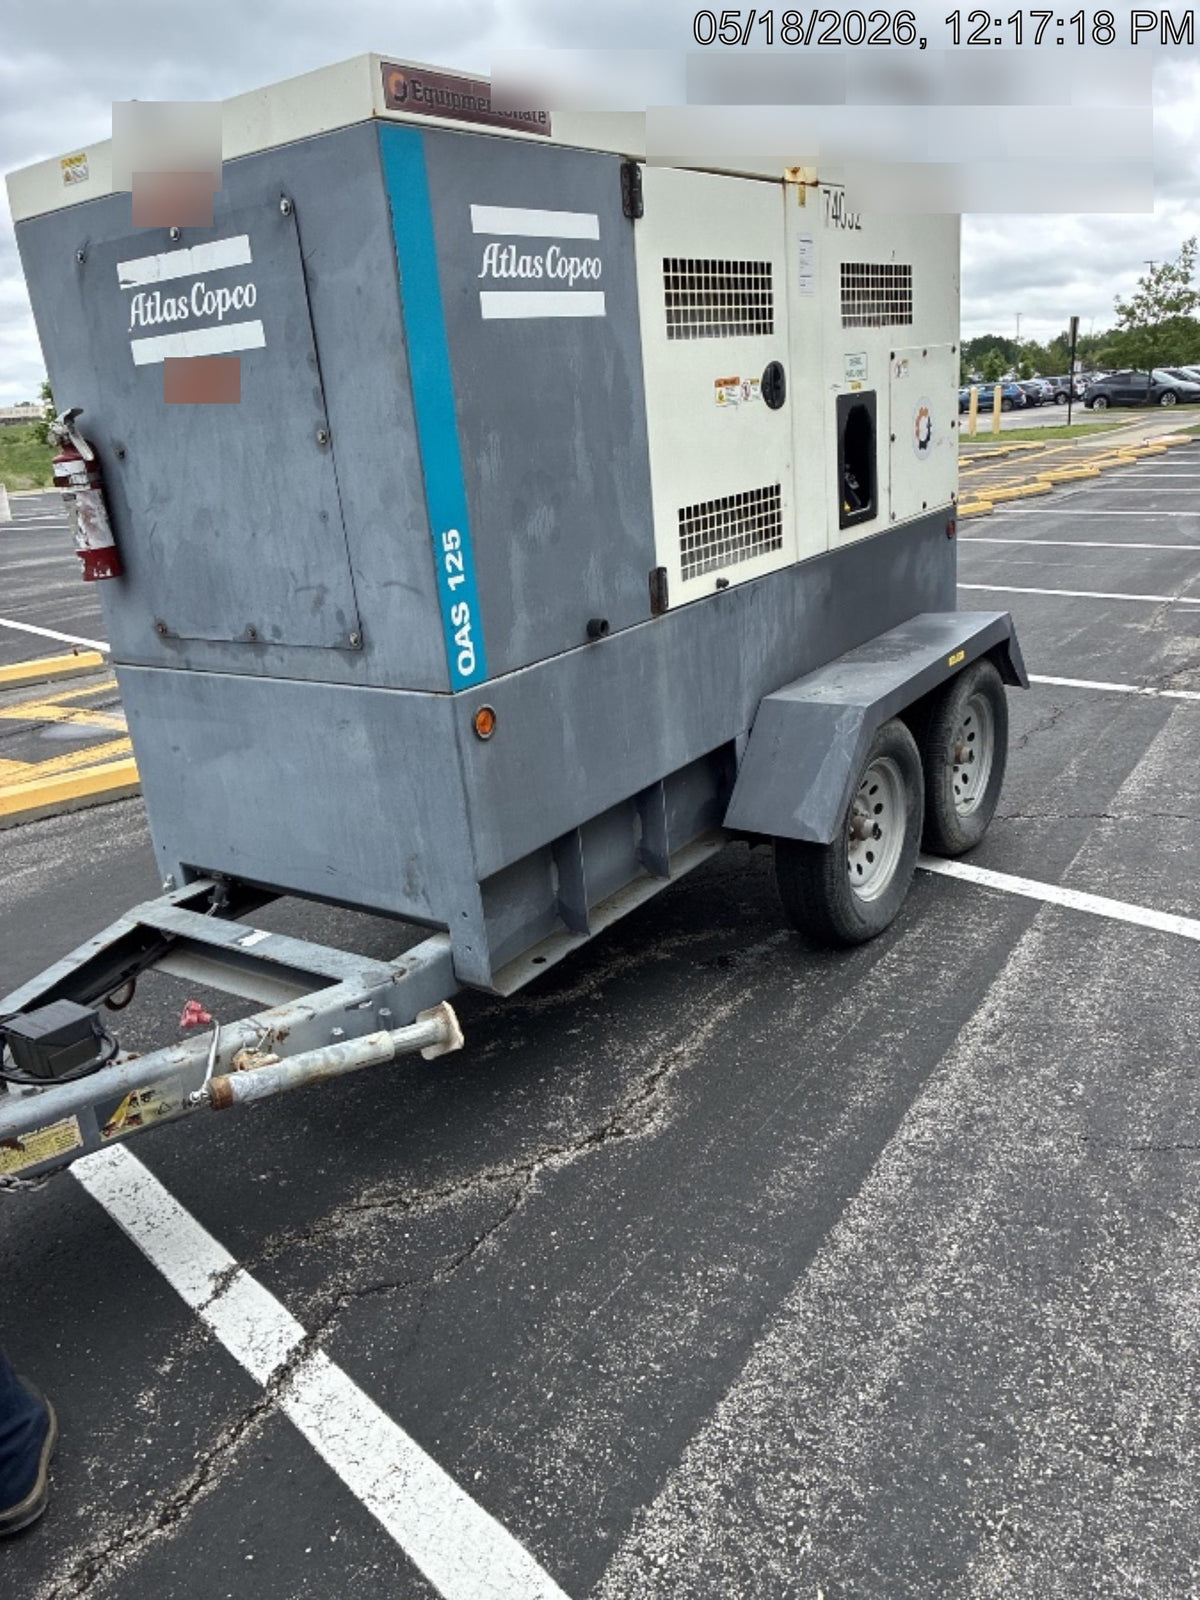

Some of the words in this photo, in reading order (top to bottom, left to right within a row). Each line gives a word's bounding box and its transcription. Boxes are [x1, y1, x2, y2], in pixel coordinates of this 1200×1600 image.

[410, 79, 547, 124] Equipmeare
[478, 242, 543, 279] Atlas
[545, 245, 602, 287] Copco
[128, 290, 190, 333] Atlas
[191, 282, 257, 321] Copco
[442, 528, 466, 592] 125
[451, 601, 476, 676] QAS
